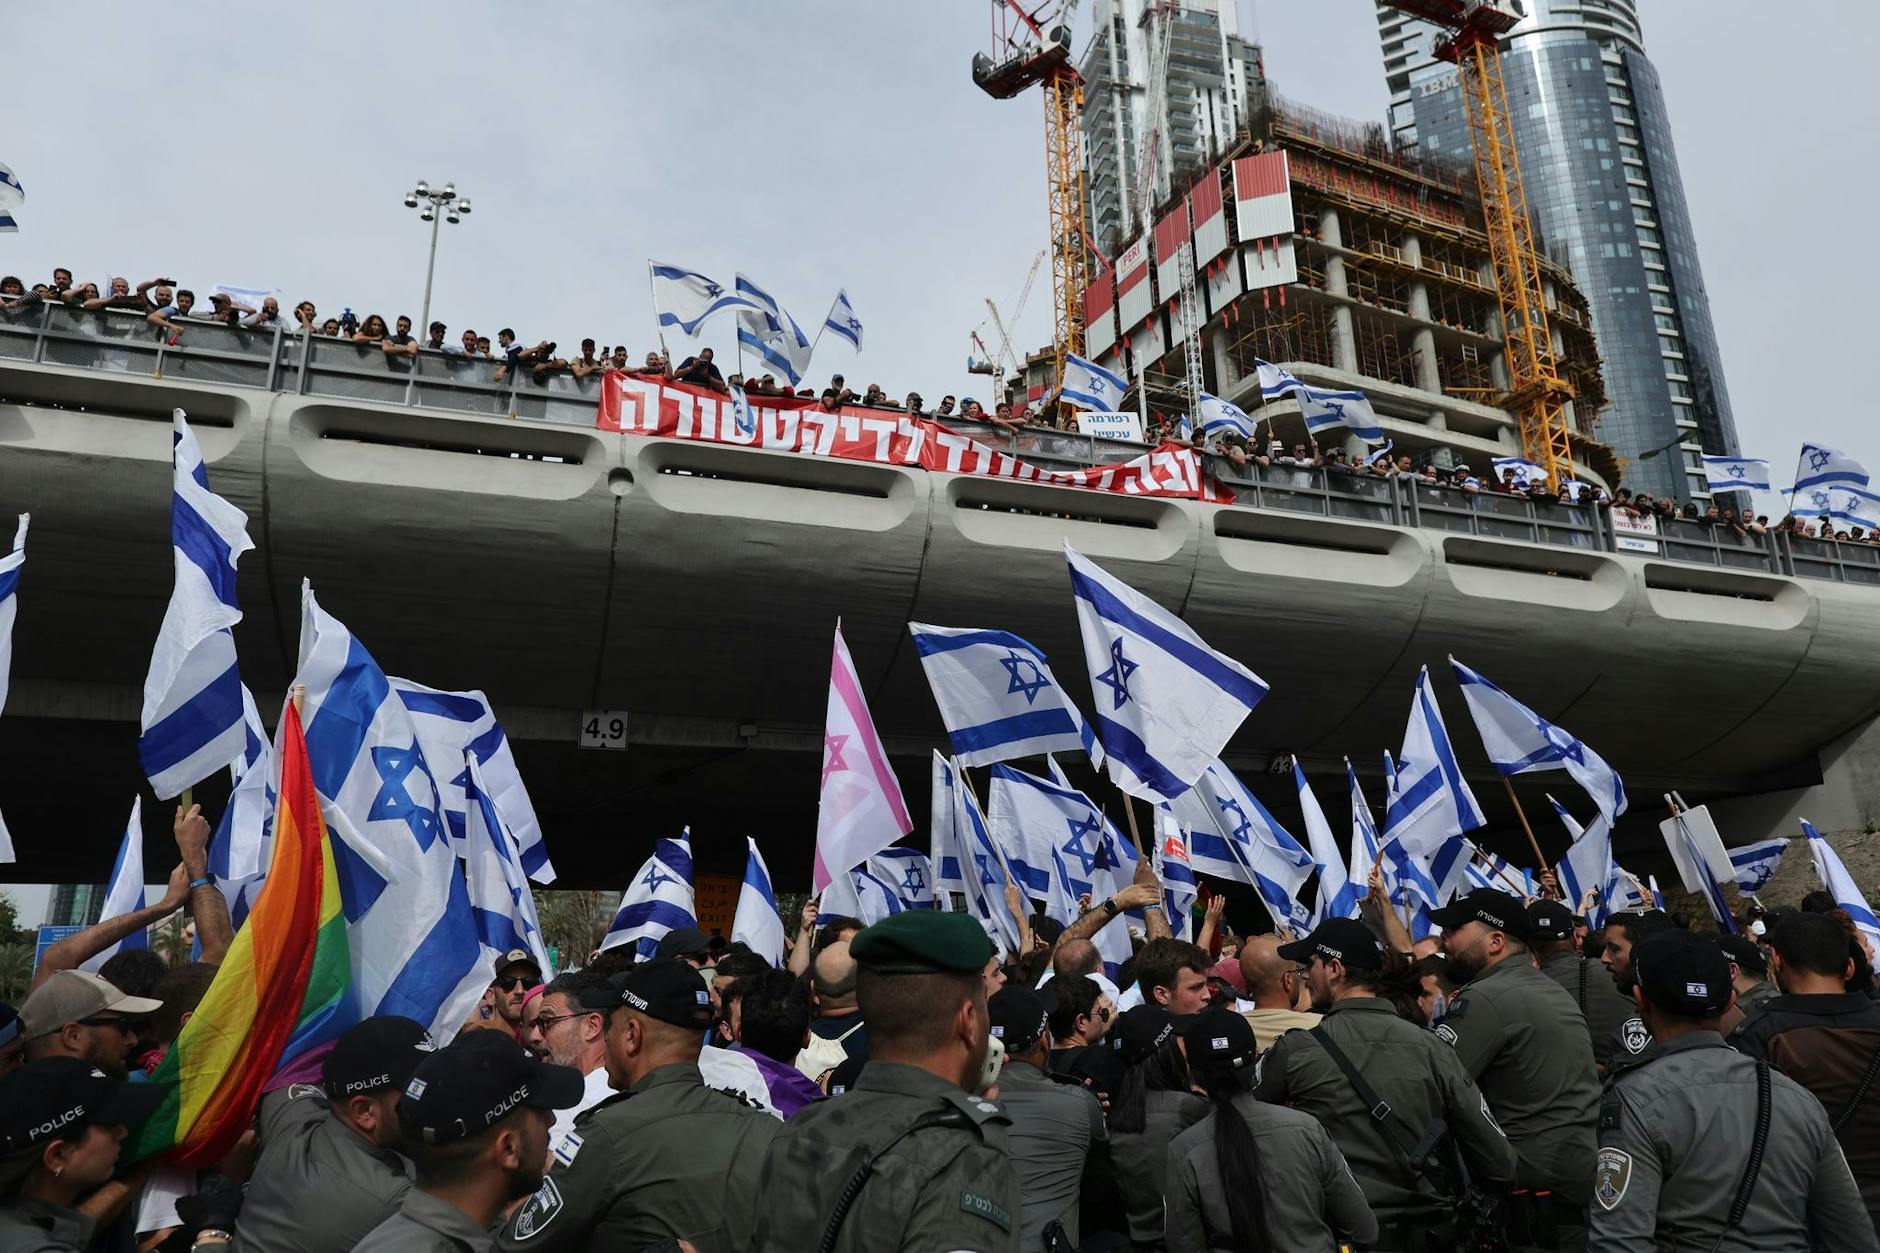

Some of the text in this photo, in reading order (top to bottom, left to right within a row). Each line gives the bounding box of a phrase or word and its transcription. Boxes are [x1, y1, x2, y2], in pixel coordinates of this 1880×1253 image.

[1419, 75, 1457, 97] IBM
[1122, 243, 1141, 267] PERI
[1087, 415, 1130, 423] רפורמה
[1093, 429, 1130, 438] עכשיו!
[585, 718, 624, 740] 4.9
[701, 912, 727, 923] EXIT
[1476, 909, 1505, 928] משטרה
[1316, 943, 1342, 959] משטרה
[621, 989, 649, 1011] משטרה
[1153, 1022, 1174, 1047] POLICE
[346, 1073, 391, 1094] POLICE
[485, 1084, 530, 1125] POLICE
[29, 1104, 86, 1141] POLICE
